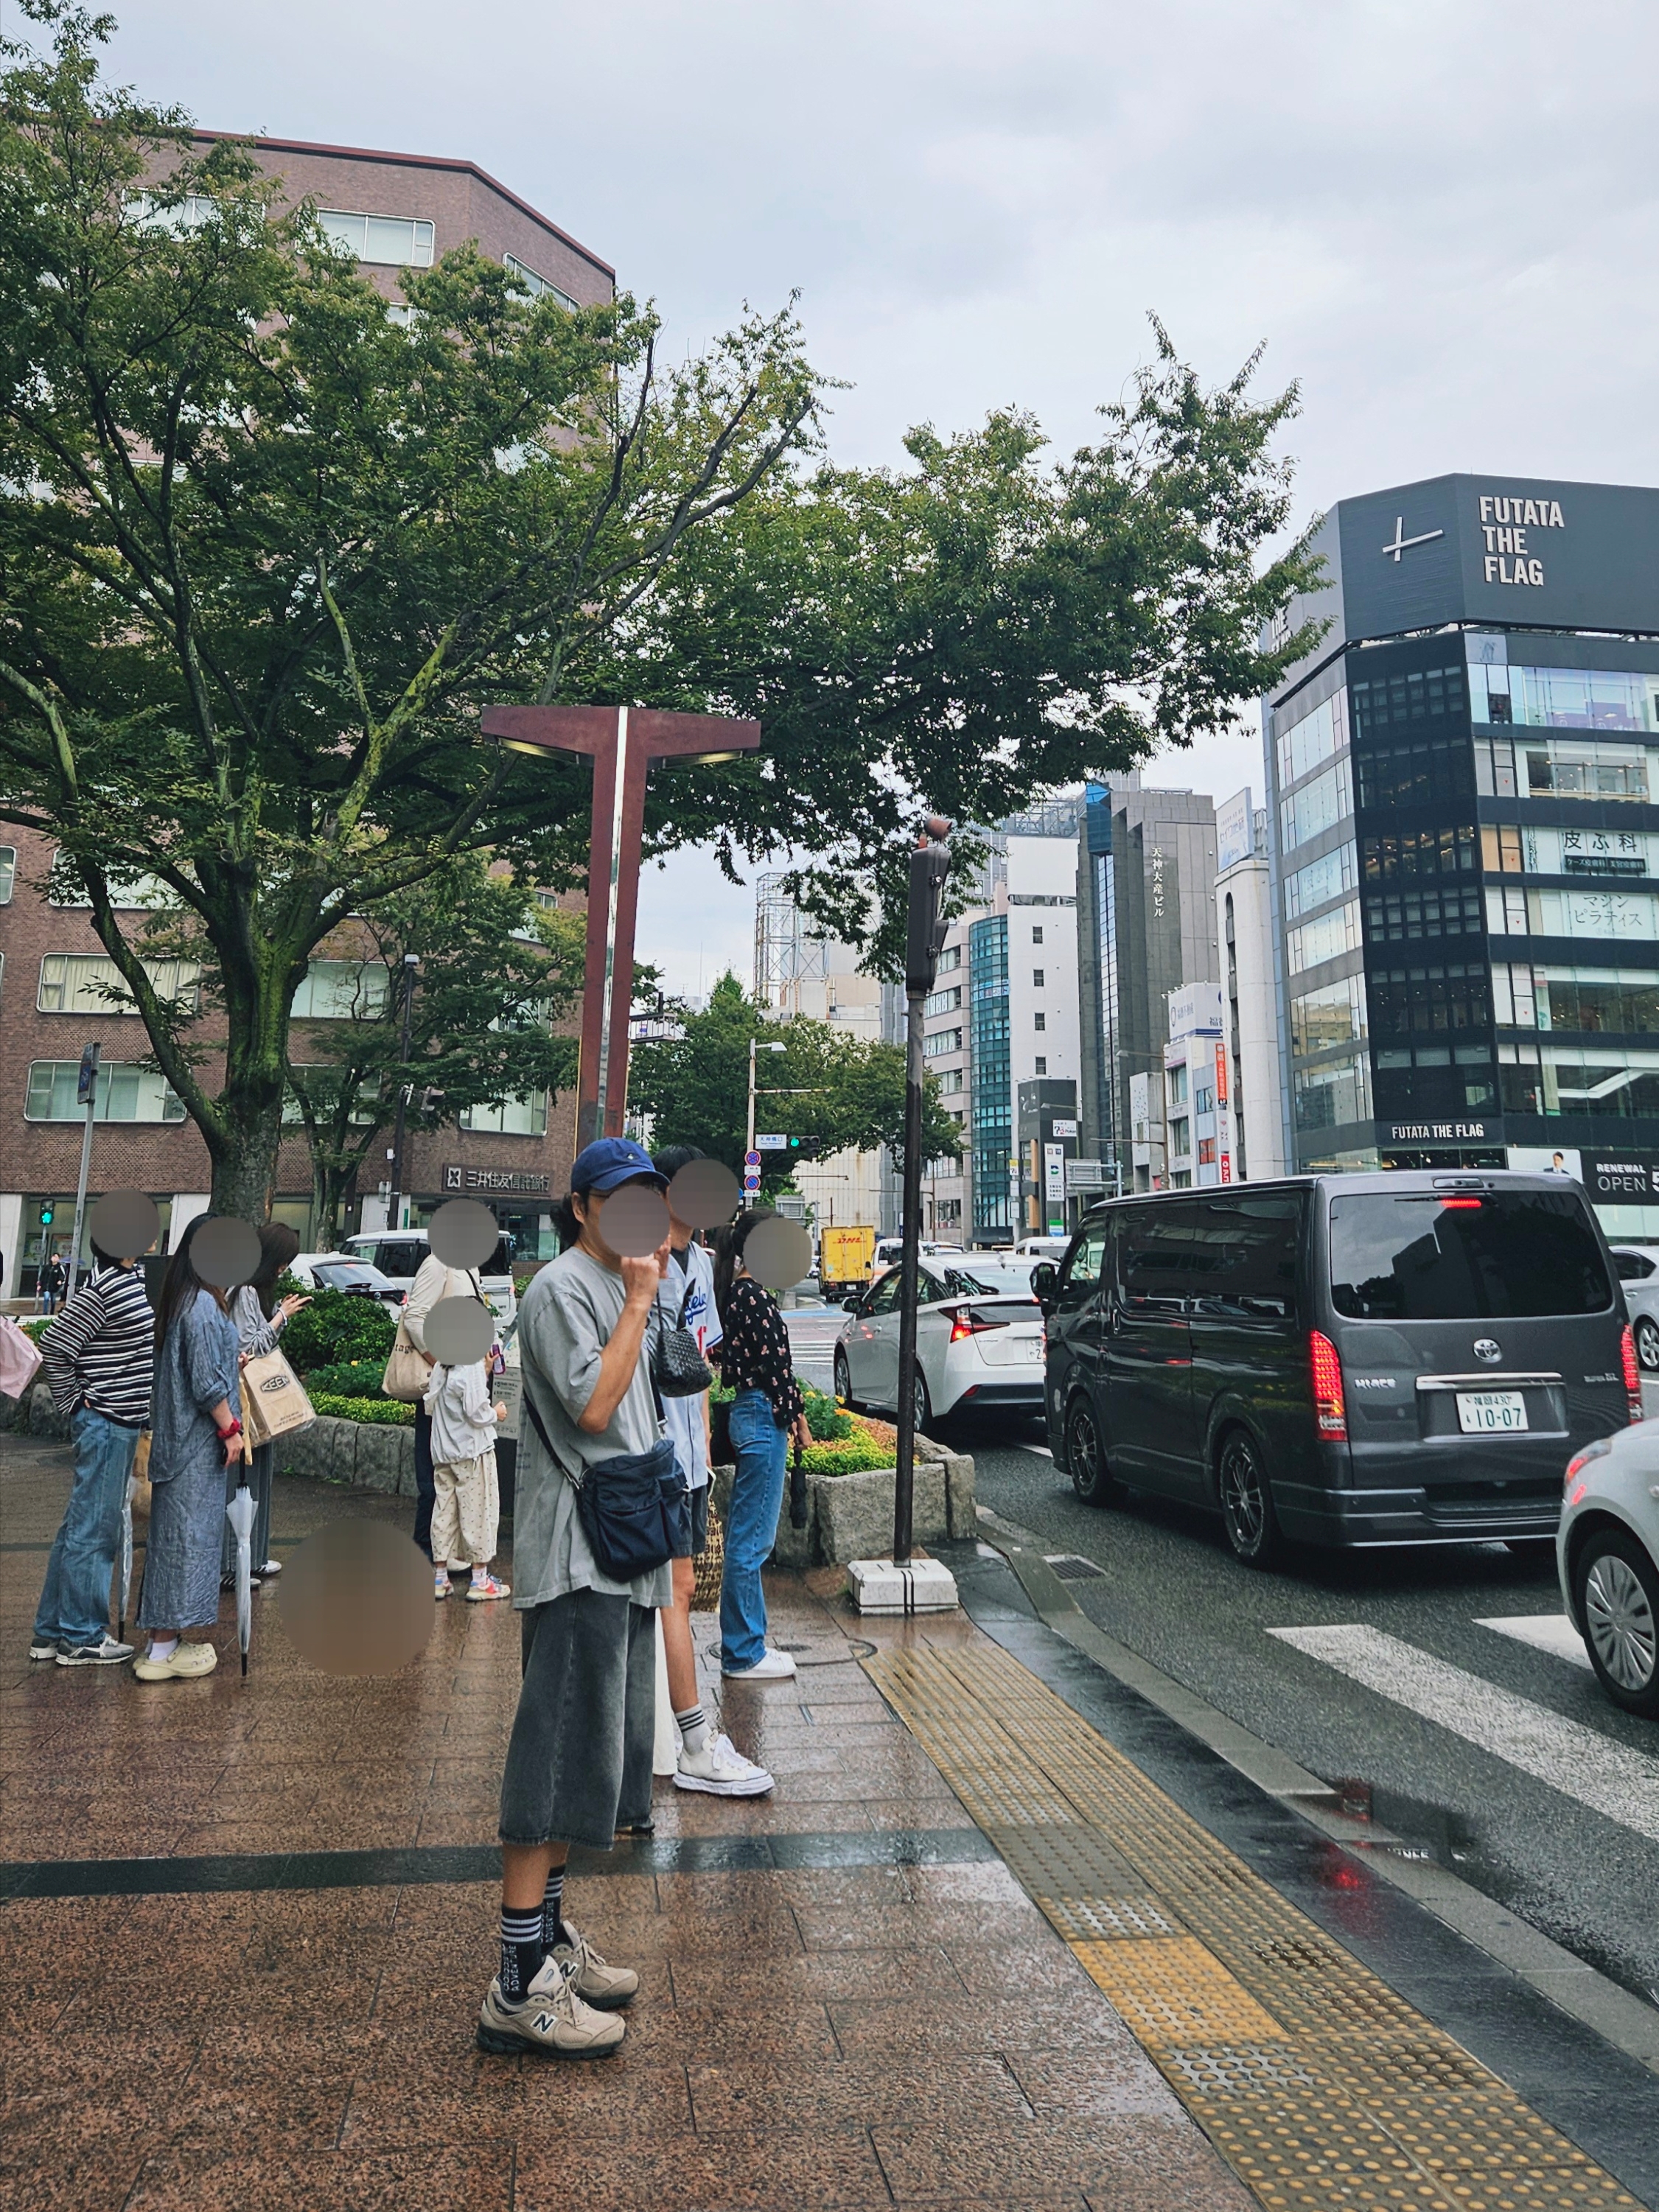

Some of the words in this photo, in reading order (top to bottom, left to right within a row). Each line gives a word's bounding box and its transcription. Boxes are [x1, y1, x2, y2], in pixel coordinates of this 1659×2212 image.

[1479, 495, 1565, 528] FUTATA
[1481, 525, 1528, 555] THE
[1484, 556, 1543, 586] FLAG
[1564, 830, 1637, 853] 皮ふ科
[1152, 847, 1164, 917] 天神大産ビル
[1583, 895, 1628, 908] マシン
[1574, 909, 1643, 926] ピラティス
[1391, 1125, 1430, 1139] FUTATA
[1432, 1124, 1453, 1138] THE
[1456, 1123, 1484, 1138] FLAG
[1596, 1163, 1646, 1173] RENEWAL
[466, 1170, 550, 1191] 三井住友信託銀行
[1598, 1176, 1646, 1191] OPEN
[261, 1376, 290, 1393] KEEN
[1476, 1408, 1520, 1428] 10-07
[545, 1900, 554, 1944] ADVENTURE
[509, 1945, 520, 1992] ADVENTURE
[530, 2010, 559, 2035] N
